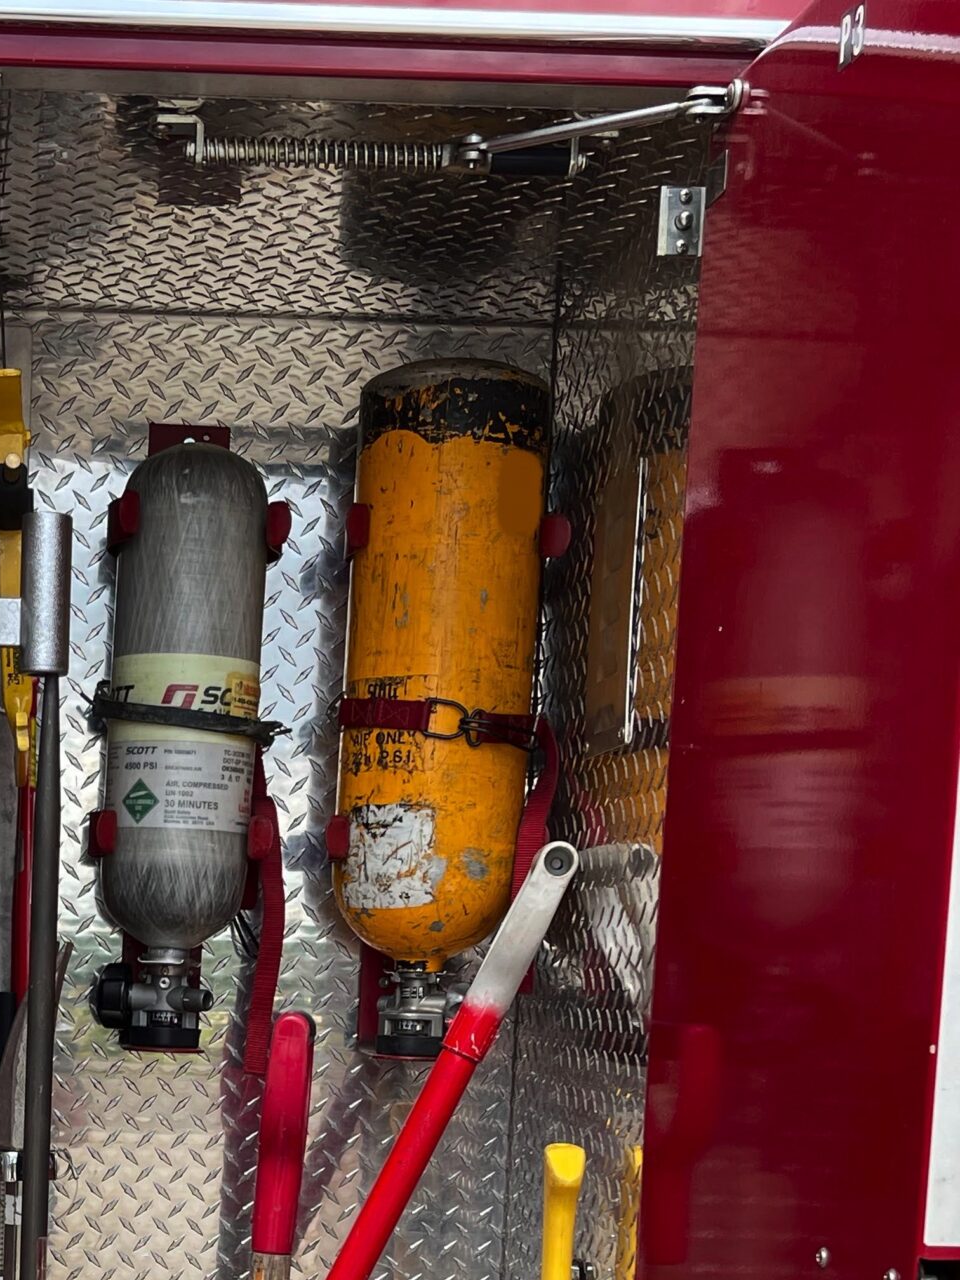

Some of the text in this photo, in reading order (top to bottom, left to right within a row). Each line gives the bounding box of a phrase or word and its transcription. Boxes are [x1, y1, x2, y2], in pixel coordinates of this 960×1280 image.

[126, 746, 158, 756] SCOTT
[124, 761, 158, 770] 4500 PSI
[165, 780, 229, 790] AIR, COMPRESSED
[164, 799, 219, 811] 30 MINUTES
